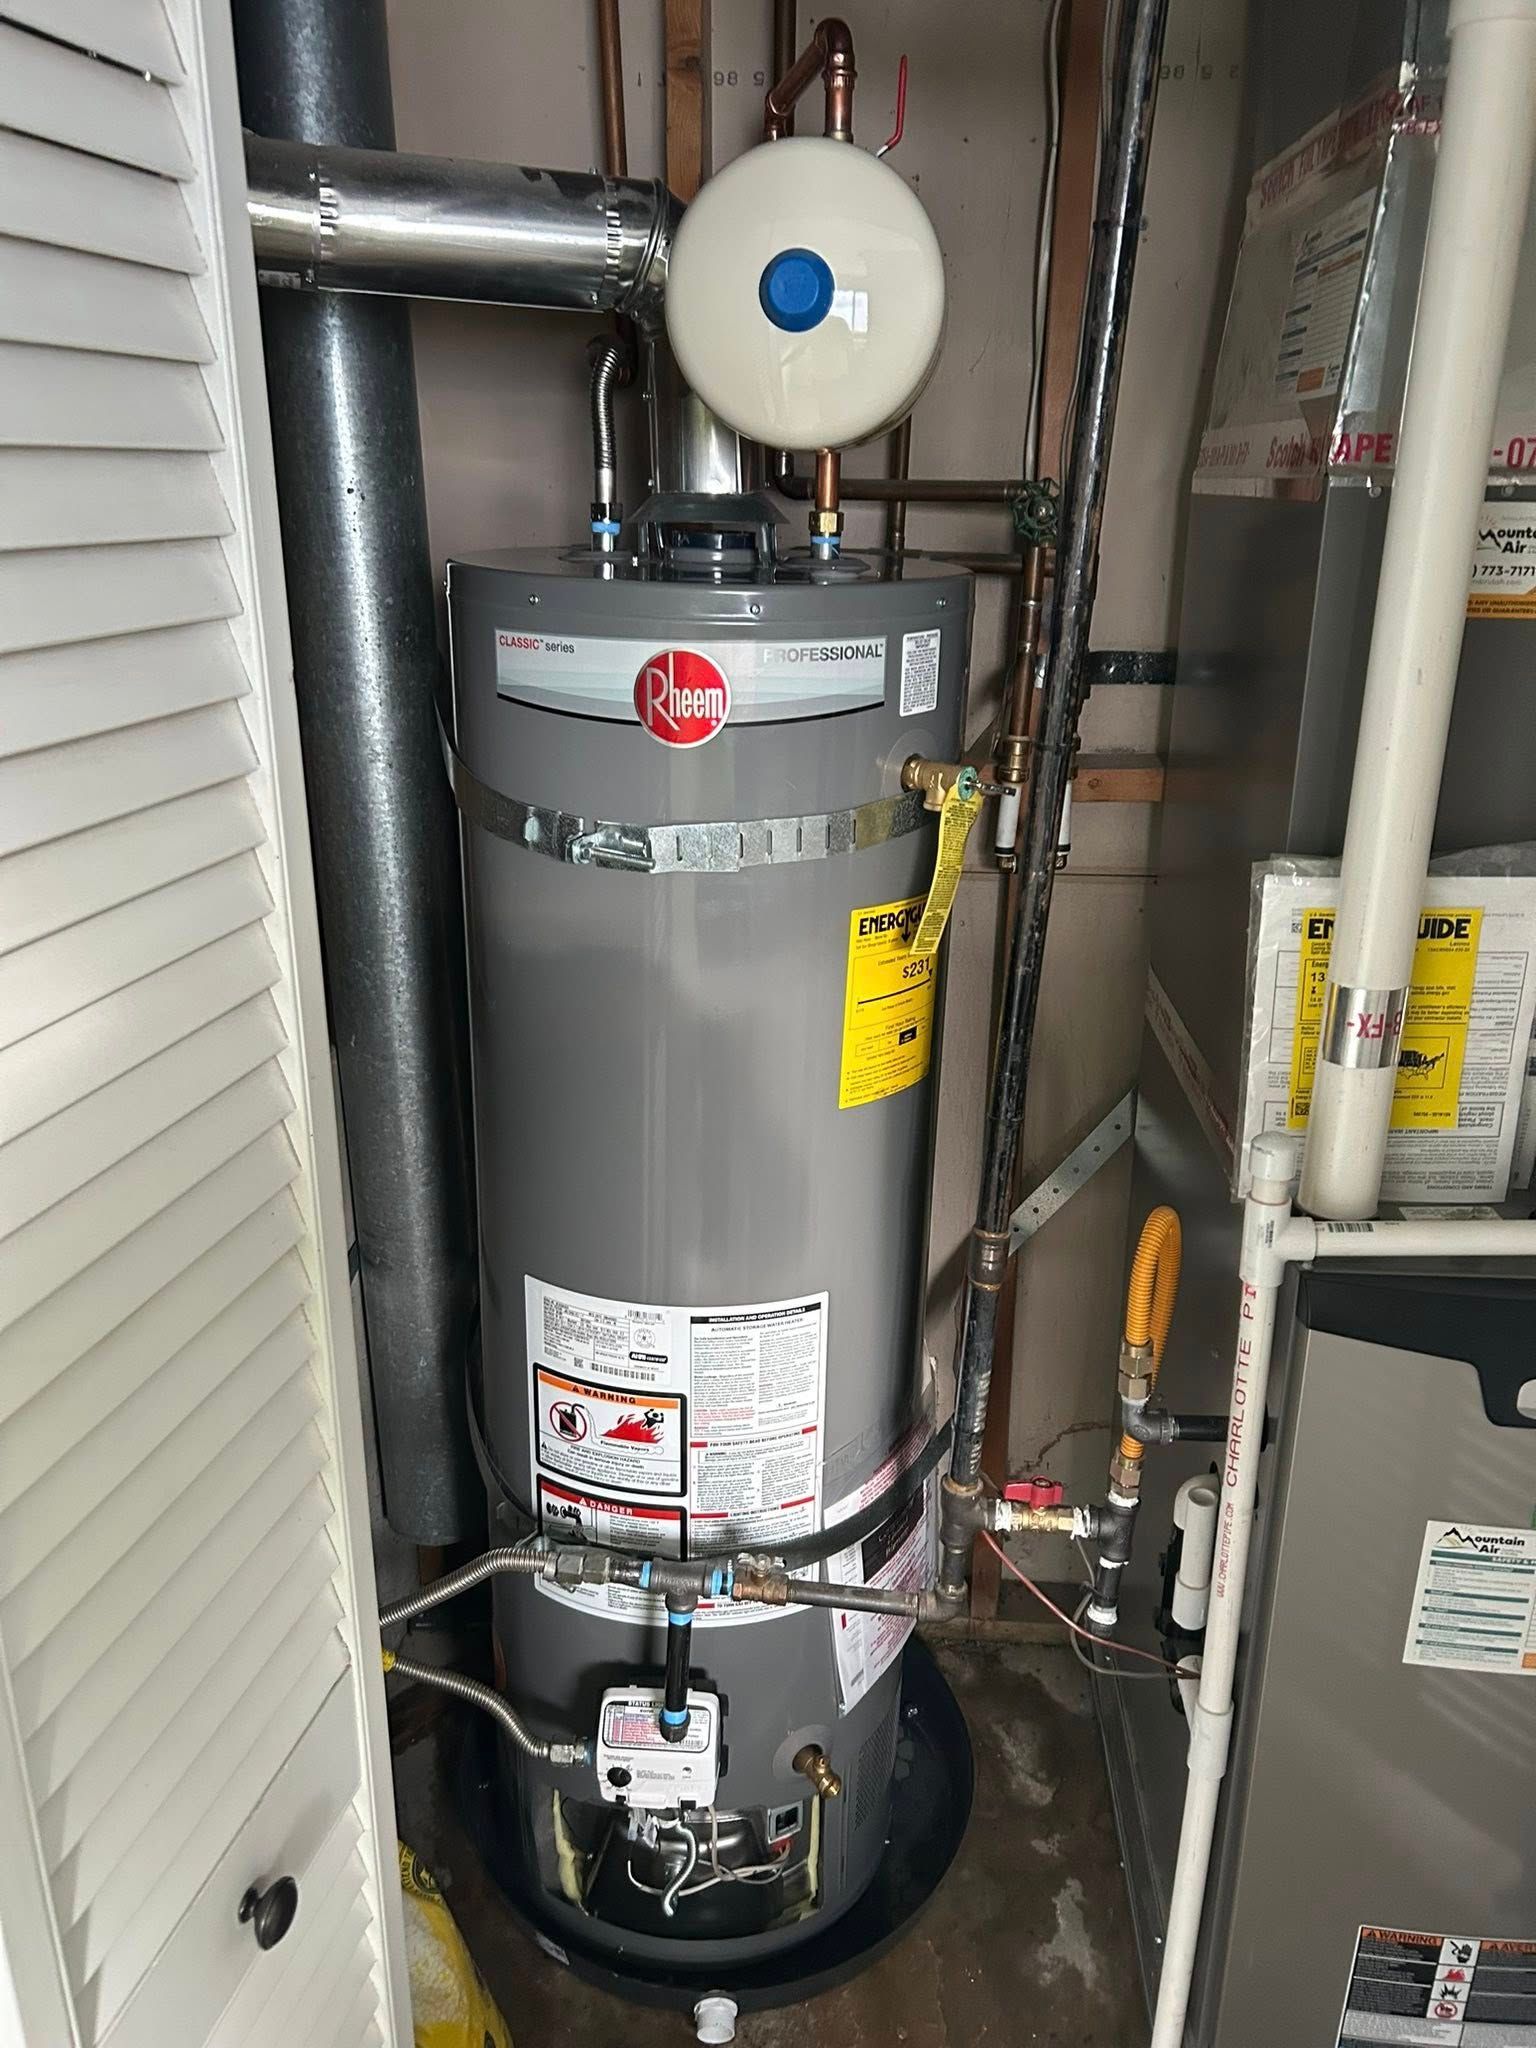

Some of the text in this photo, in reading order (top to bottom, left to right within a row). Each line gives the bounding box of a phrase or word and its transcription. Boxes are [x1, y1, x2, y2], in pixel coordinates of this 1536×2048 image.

[1502, 540, 1527, 554] Air
[545, 641, 575, 654] series
[646, 651, 723, 731] Rheem
[1308, 918, 1335, 939] EN
[1416, 918, 1471, 939] UIDE
[902, 956, 930, 979] $231
[584, 1386, 636, 1404] WARNING
[1226, 1337, 1252, 1488] CHARLOTTE
[590, 1501, 633, 1516] DANGER
[1478, 1544, 1501, 1554] Air
[1380, 1930, 1437, 1946] WARNING
